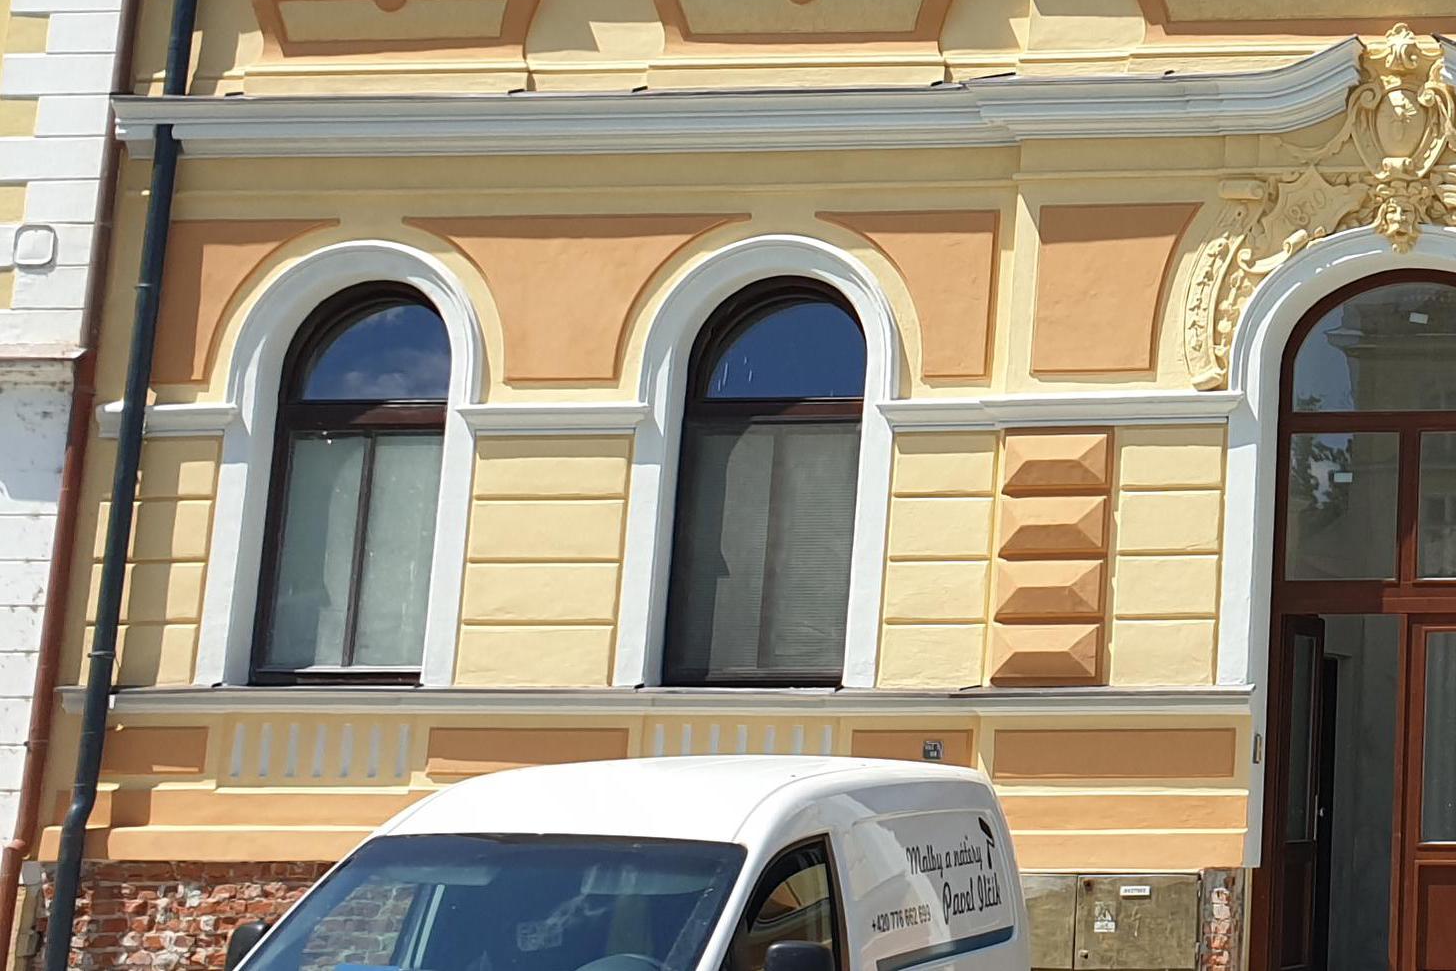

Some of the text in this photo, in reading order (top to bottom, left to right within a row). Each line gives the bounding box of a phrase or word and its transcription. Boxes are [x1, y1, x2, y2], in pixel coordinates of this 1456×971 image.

[906, 845, 943, 879] Malby
[946, 850, 953, 869] a
[942, 877, 976, 925] Pavel
[872, 913, 889, 932] +420
[889, 909, 904, 928] 776
